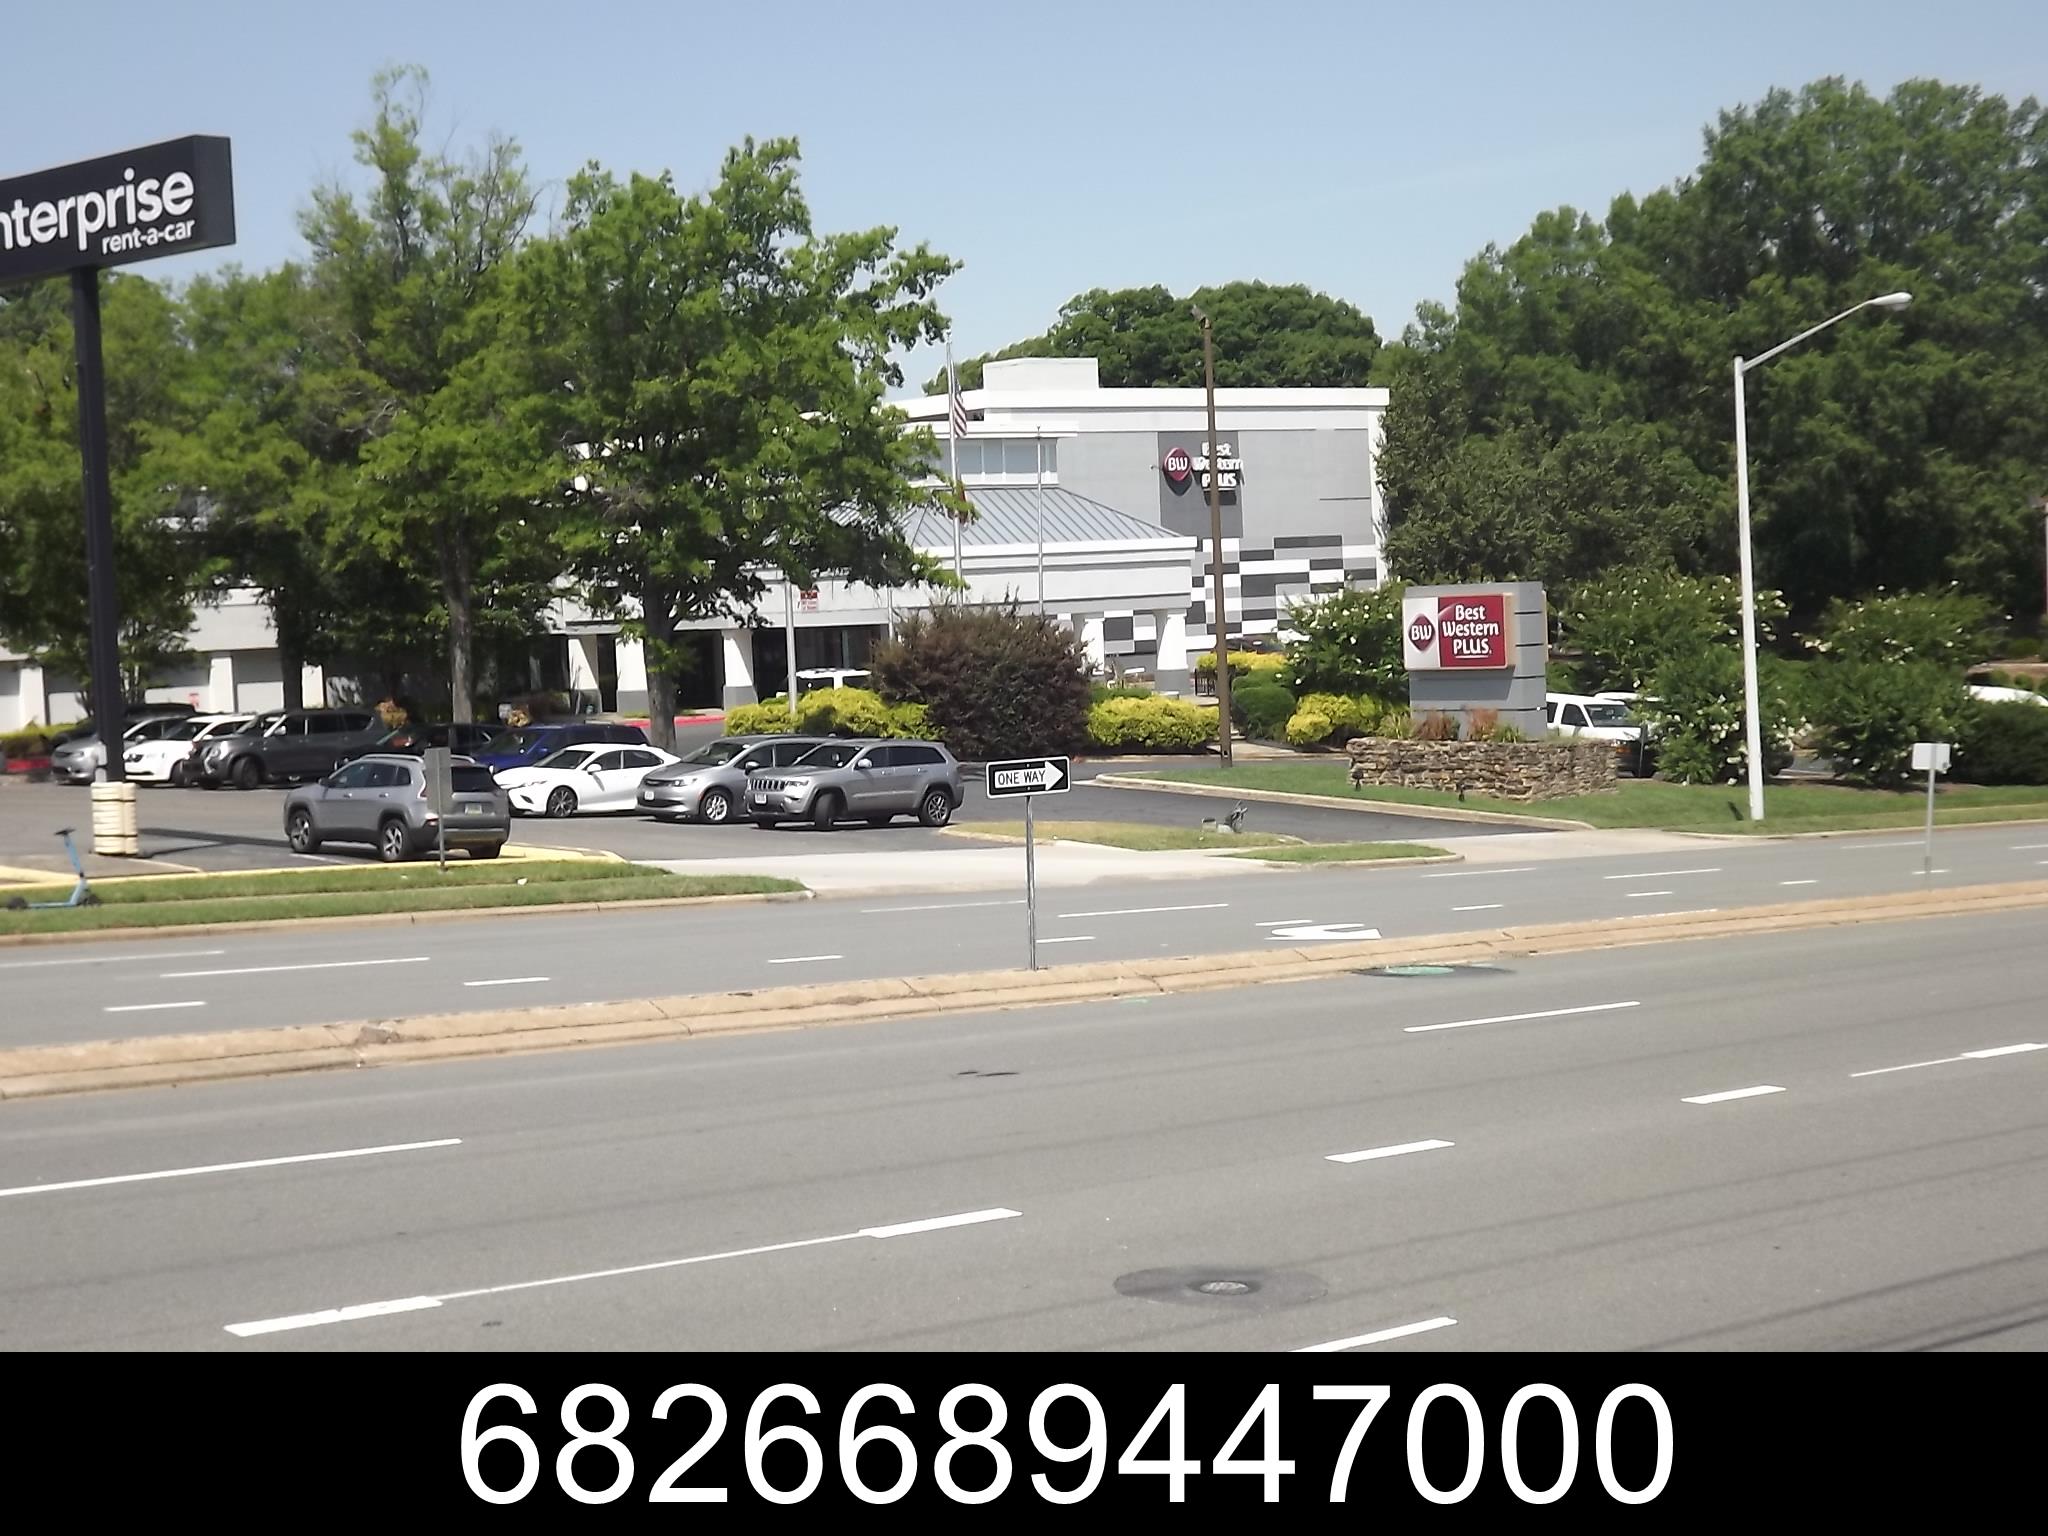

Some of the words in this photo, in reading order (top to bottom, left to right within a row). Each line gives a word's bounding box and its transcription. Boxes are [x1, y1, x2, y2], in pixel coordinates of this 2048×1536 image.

[102, 219, 195, 254] rent-a-car
[1201, 442, 1232, 456] Bst
[1168, 457, 1188, 471] BW
[1192, 457, 1243, 470] Wetern
[1202, 473, 1237, 487] PUS
[1455, 605, 1486, 621] Best
[1411, 624, 1432, 641] BW
[1442, 620, 1499, 638] Western
[998, 772, 1020, 785] ONE
[1023, 770, 1046, 783] WAY
